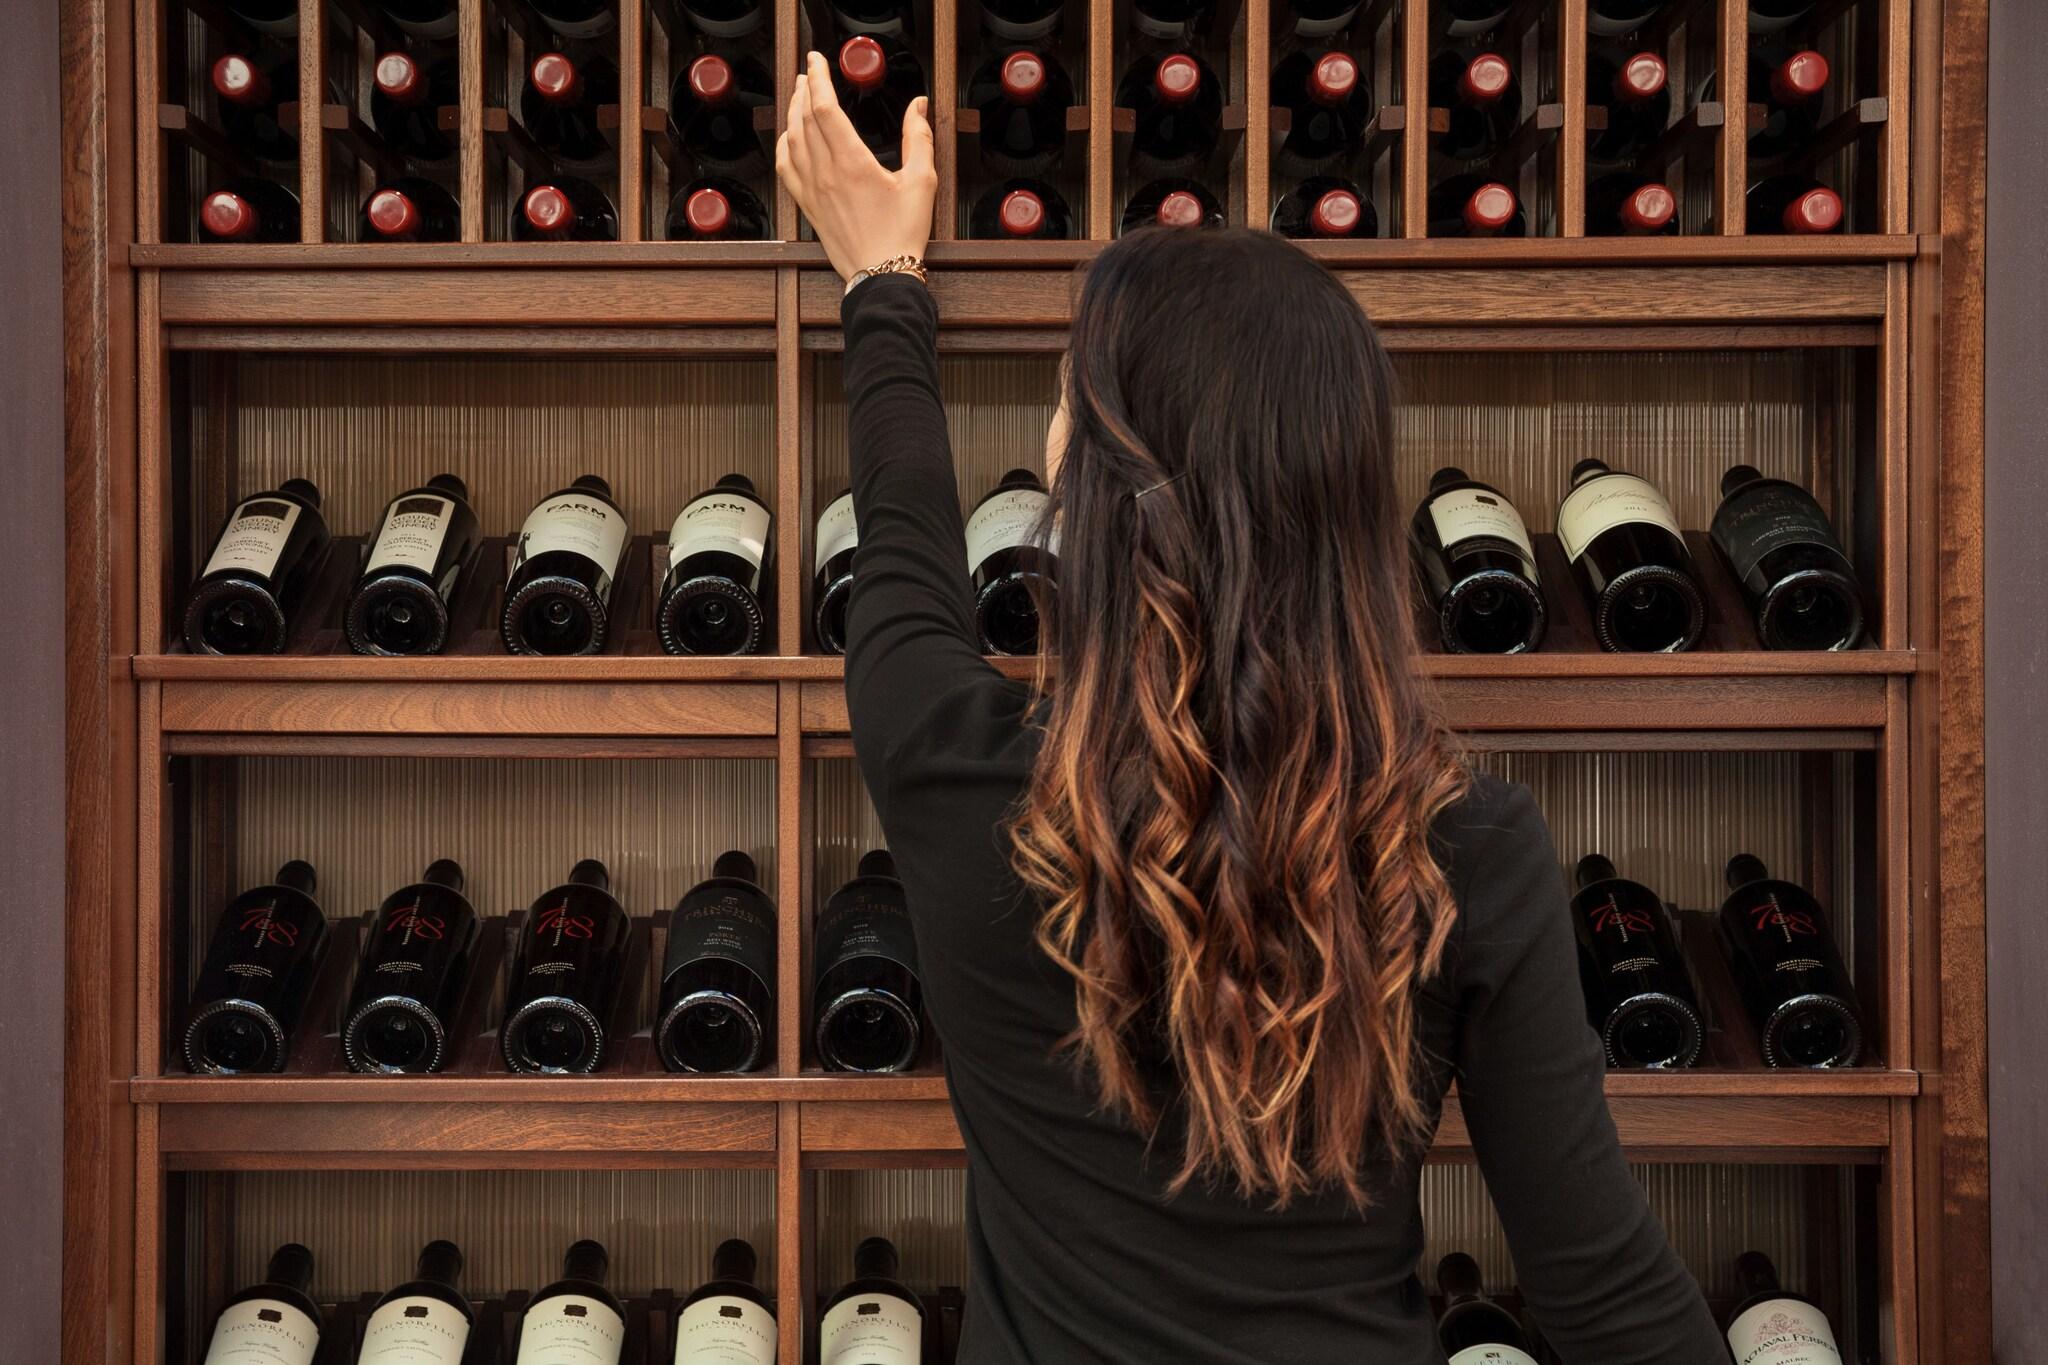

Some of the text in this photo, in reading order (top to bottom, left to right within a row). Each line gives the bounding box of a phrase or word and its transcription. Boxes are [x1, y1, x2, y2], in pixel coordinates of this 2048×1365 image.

[546, 503, 606, 519] FARM
[687, 503, 745, 519] FARM
[1744, 1335, 1788, 1365] ACHAVAL
